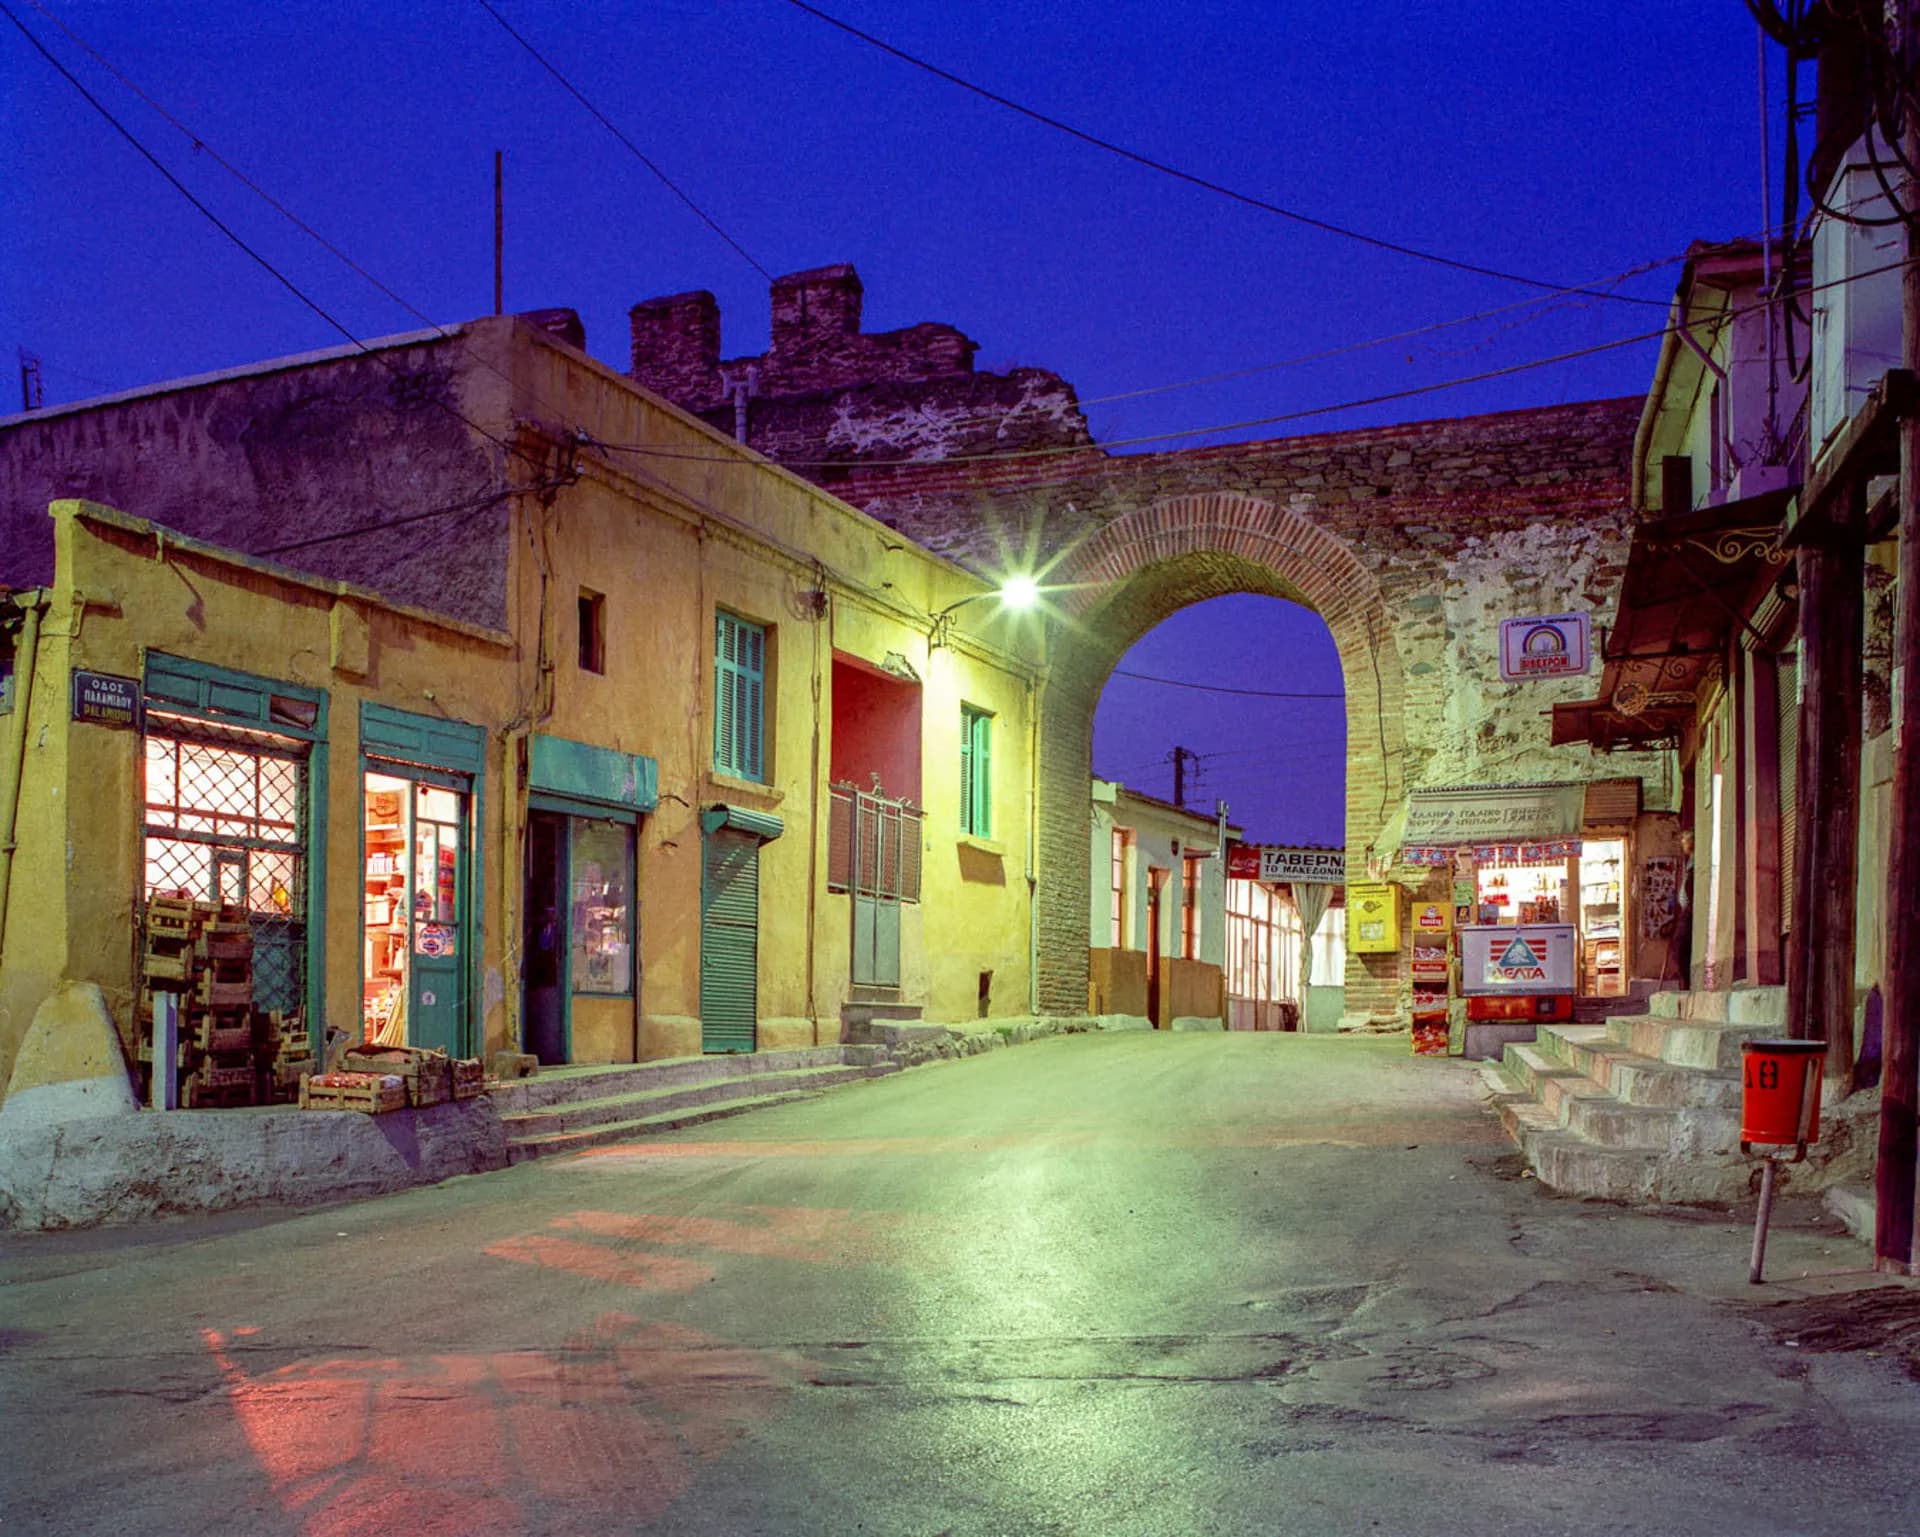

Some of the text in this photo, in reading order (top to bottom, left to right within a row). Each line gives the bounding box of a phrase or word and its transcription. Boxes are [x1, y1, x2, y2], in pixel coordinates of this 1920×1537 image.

[92, 680, 124, 694] ΟΔΟΣ
[1264, 853, 1345, 867] ΤΑΒΕΡΝ
[1265, 865, 1278, 873] ΤΟ
